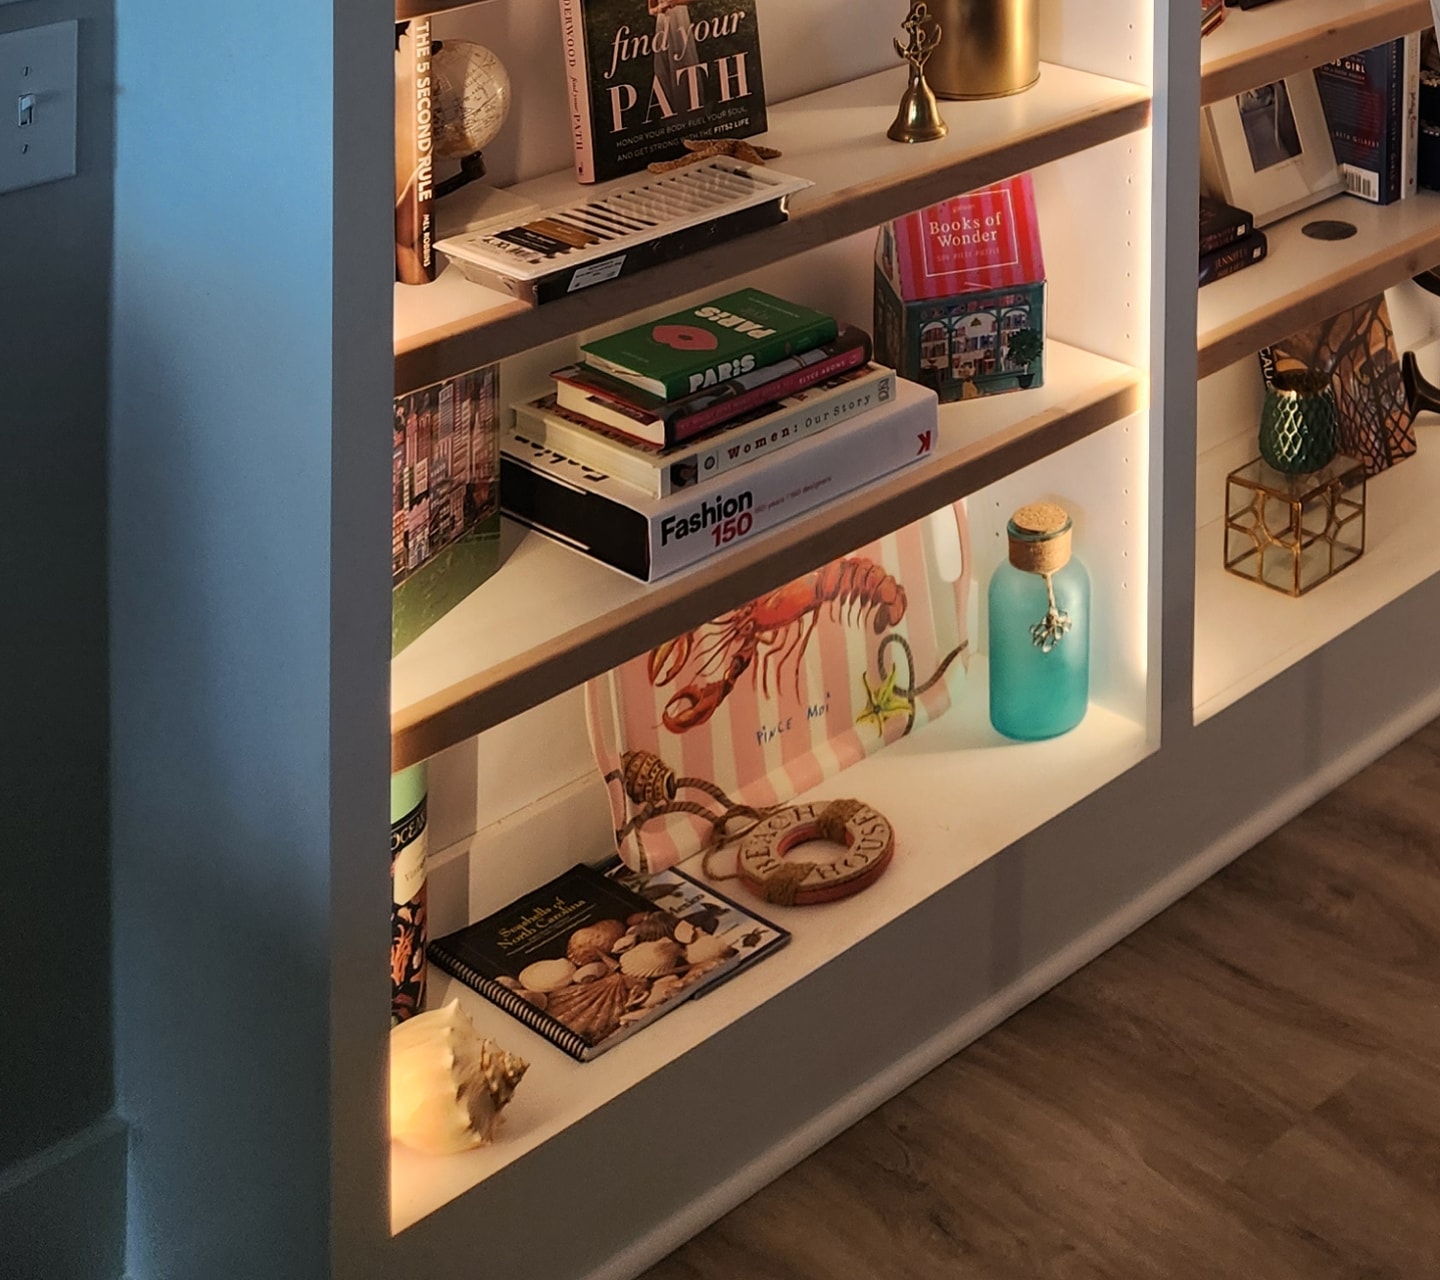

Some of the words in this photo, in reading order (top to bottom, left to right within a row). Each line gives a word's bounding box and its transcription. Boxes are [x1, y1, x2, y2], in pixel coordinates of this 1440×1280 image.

[415, 21, 431, 54] THE
[603, 25, 670, 80] find
[674, 11, 746, 62] your
[606, 52, 752, 134] PATH
[416, 78, 432, 152] SECOND
[416, 154, 433, 203] RULE
[929, 218, 981, 236] Books
[985, 212, 1002, 227] of
[937, 229, 998, 248] Wonder
[694, 306, 777, 339] PARIS
[688, 355, 756, 394] PARIS
[832, 391, 871, 417] Story
[727, 421, 799, 461] Women:
[661, 489, 754, 547] Fashion
[711, 512, 754, 548] 150
[745, 804, 815, 874] BEACH
[815, 809, 884, 880] HOUSE
